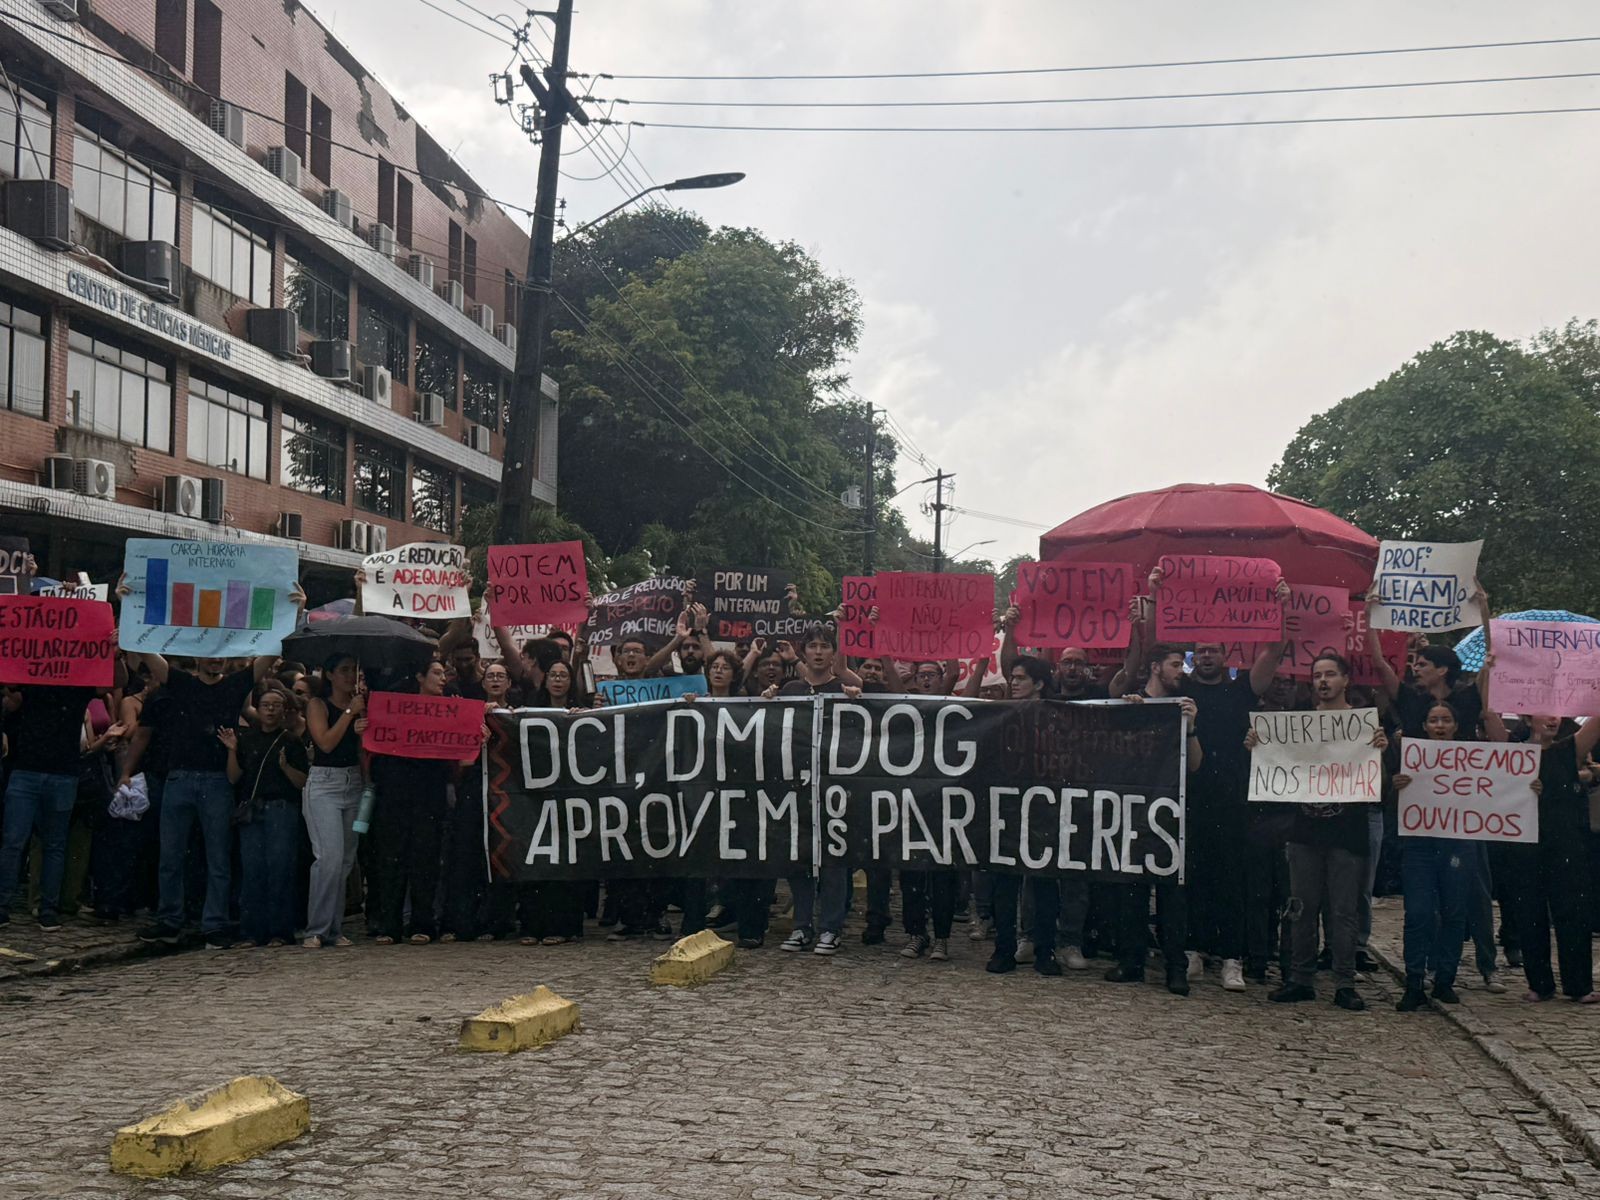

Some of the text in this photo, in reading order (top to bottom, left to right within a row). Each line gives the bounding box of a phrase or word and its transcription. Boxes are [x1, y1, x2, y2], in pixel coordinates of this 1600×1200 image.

[68, 270, 231, 361] CENTRO DE CIÊNCIAS MÉDICAS
[171, 542, 202, 556] CARGA
[366, 547, 462, 569] NÃO É REDUÇÃO
[188, 557, 236, 569] INTERNATO
[490, 554, 577, 579] VOTEM
[375, 568, 466, 589] É ADEQUAÇÃO
[714, 572, 768, 592] POR UM
[888, 577, 979, 603] INTERNATO
[1022, 566, 1125, 609] VOTEM
[392, 588, 404, 610] À
[494, 579, 582, 604] POR NÓS
[1383, 579, 1467, 605] LEIAM O
[0, 603, 78, 630] ESTÁGIO
[607, 594, 675, 620] RESPEITO
[714, 597, 780, 614] INTERNATO
[912, 603, 963, 627] NÃO É
[1391, 606, 1462, 629] PARECER
[1028, 600, 1120, 642] LOGO
[0, 637, 110, 659] EGULARIZADO
[587, 628, 613, 645] AOS
[845, 629, 874, 649] DCI
[600, 684, 672, 706] APROVA
[386, 699, 459, 718] LIBEREM
[374, 727, 399, 742] OS
[1254, 711, 1377, 745] QUEREMOS
[519, 713, 645, 790] DCI,
[665, 707, 811, 786] DMI,
[828, 703, 977, 777] DOG
[1404, 743, 1536, 776] QUEREMOS
[1255, 760, 1379, 797] NOS FORMAR
[1433, 774, 1494, 797] SER
[524, 785, 1181, 877] APROVEM OS PARECERES
[1403, 804, 1522, 837] OUVIDOS
